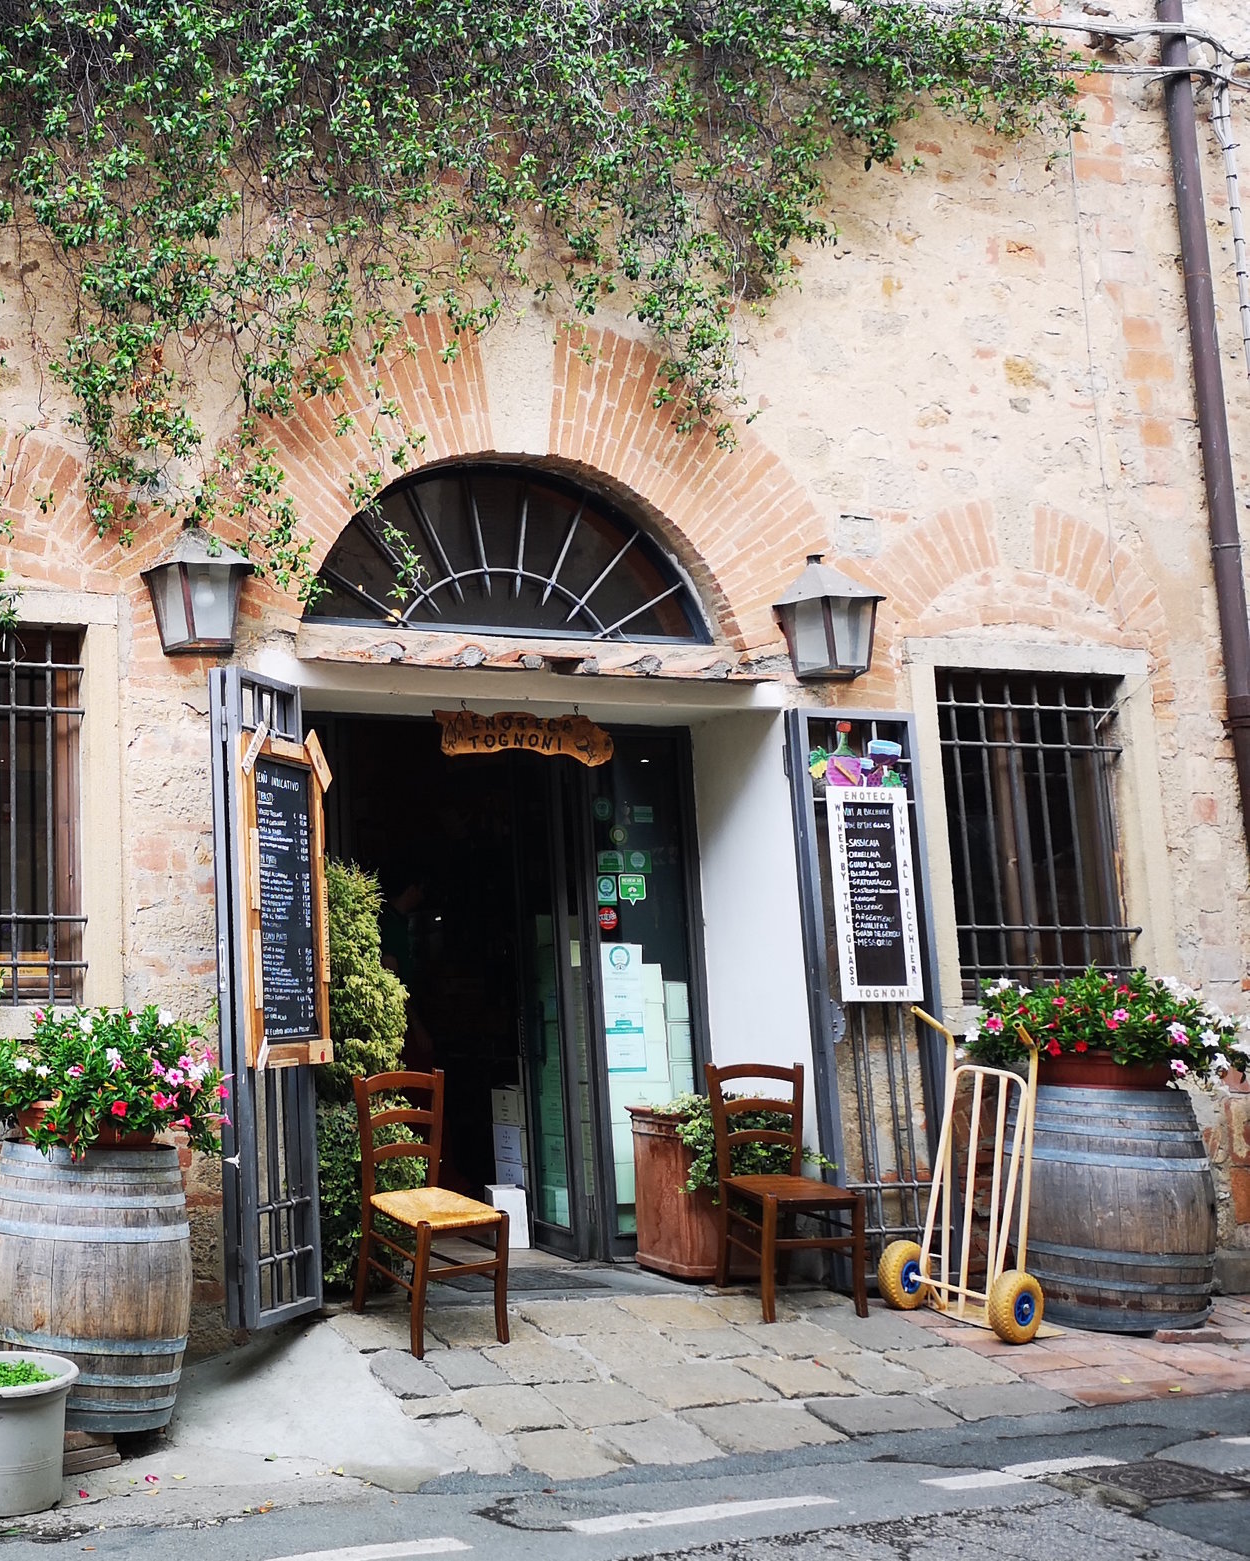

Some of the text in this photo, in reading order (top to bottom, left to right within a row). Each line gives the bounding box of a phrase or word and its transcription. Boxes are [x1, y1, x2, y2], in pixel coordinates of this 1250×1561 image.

[470, 715, 574, 734] ENOTECA
[468, 732, 562, 751] TOGNONI
[271, 775, 299, 792] INDICATIVO
[844, 791, 894, 801] ENOTECA
[872, 821, 891, 830] GLASS
[849, 860, 892, 869] GUADO AL TASSO
[835, 803, 855, 986] WINES BY THE GLASS
[897, 805, 918, 986] VINI AL BICCHIERE
[855, 903, 884, 911] BISERNO
[855, 929, 873, 938] GUADO
[859, 989, 910, 998] TOGNONI
